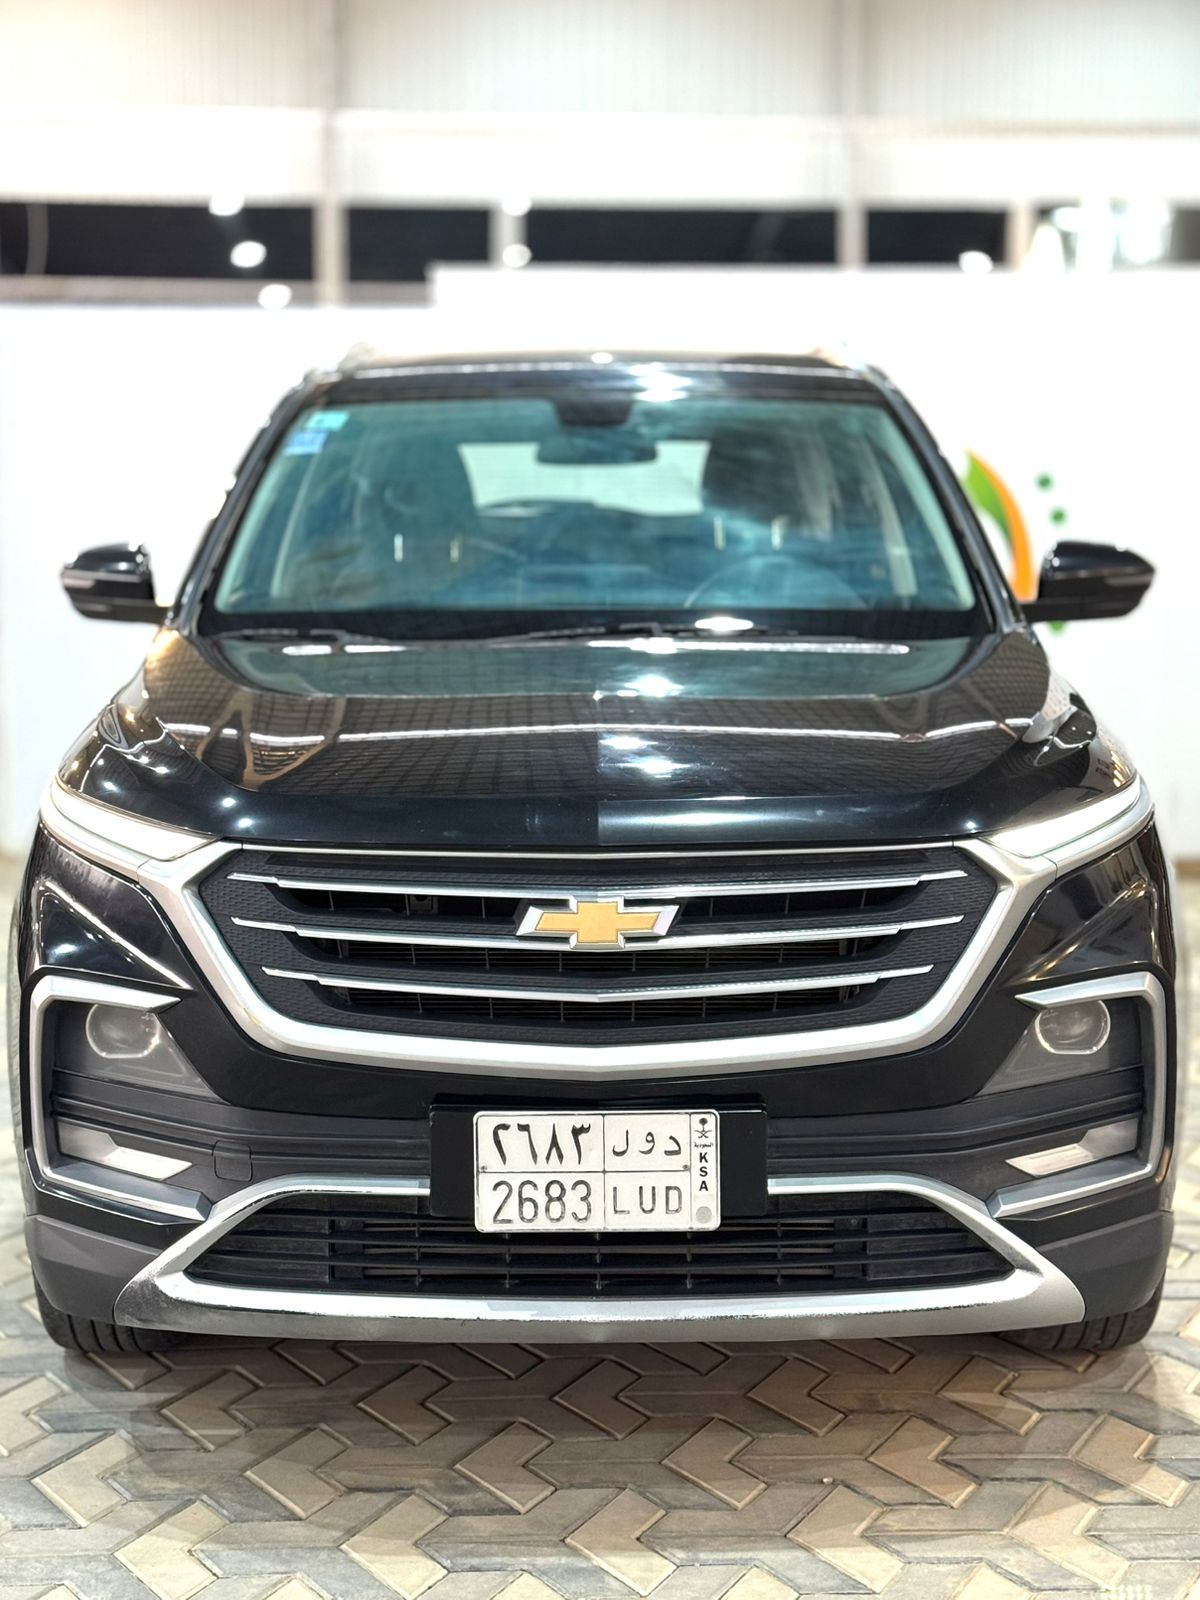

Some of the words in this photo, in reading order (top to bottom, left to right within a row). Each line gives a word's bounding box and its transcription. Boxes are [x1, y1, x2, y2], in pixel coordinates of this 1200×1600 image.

[492, 1122, 591, 1165] ٢٦٨٣
[699, 1152, 709, 1192] KSA
[492, 1179, 592, 1224] 2683
[612, 1185, 683, 1215] LUD
